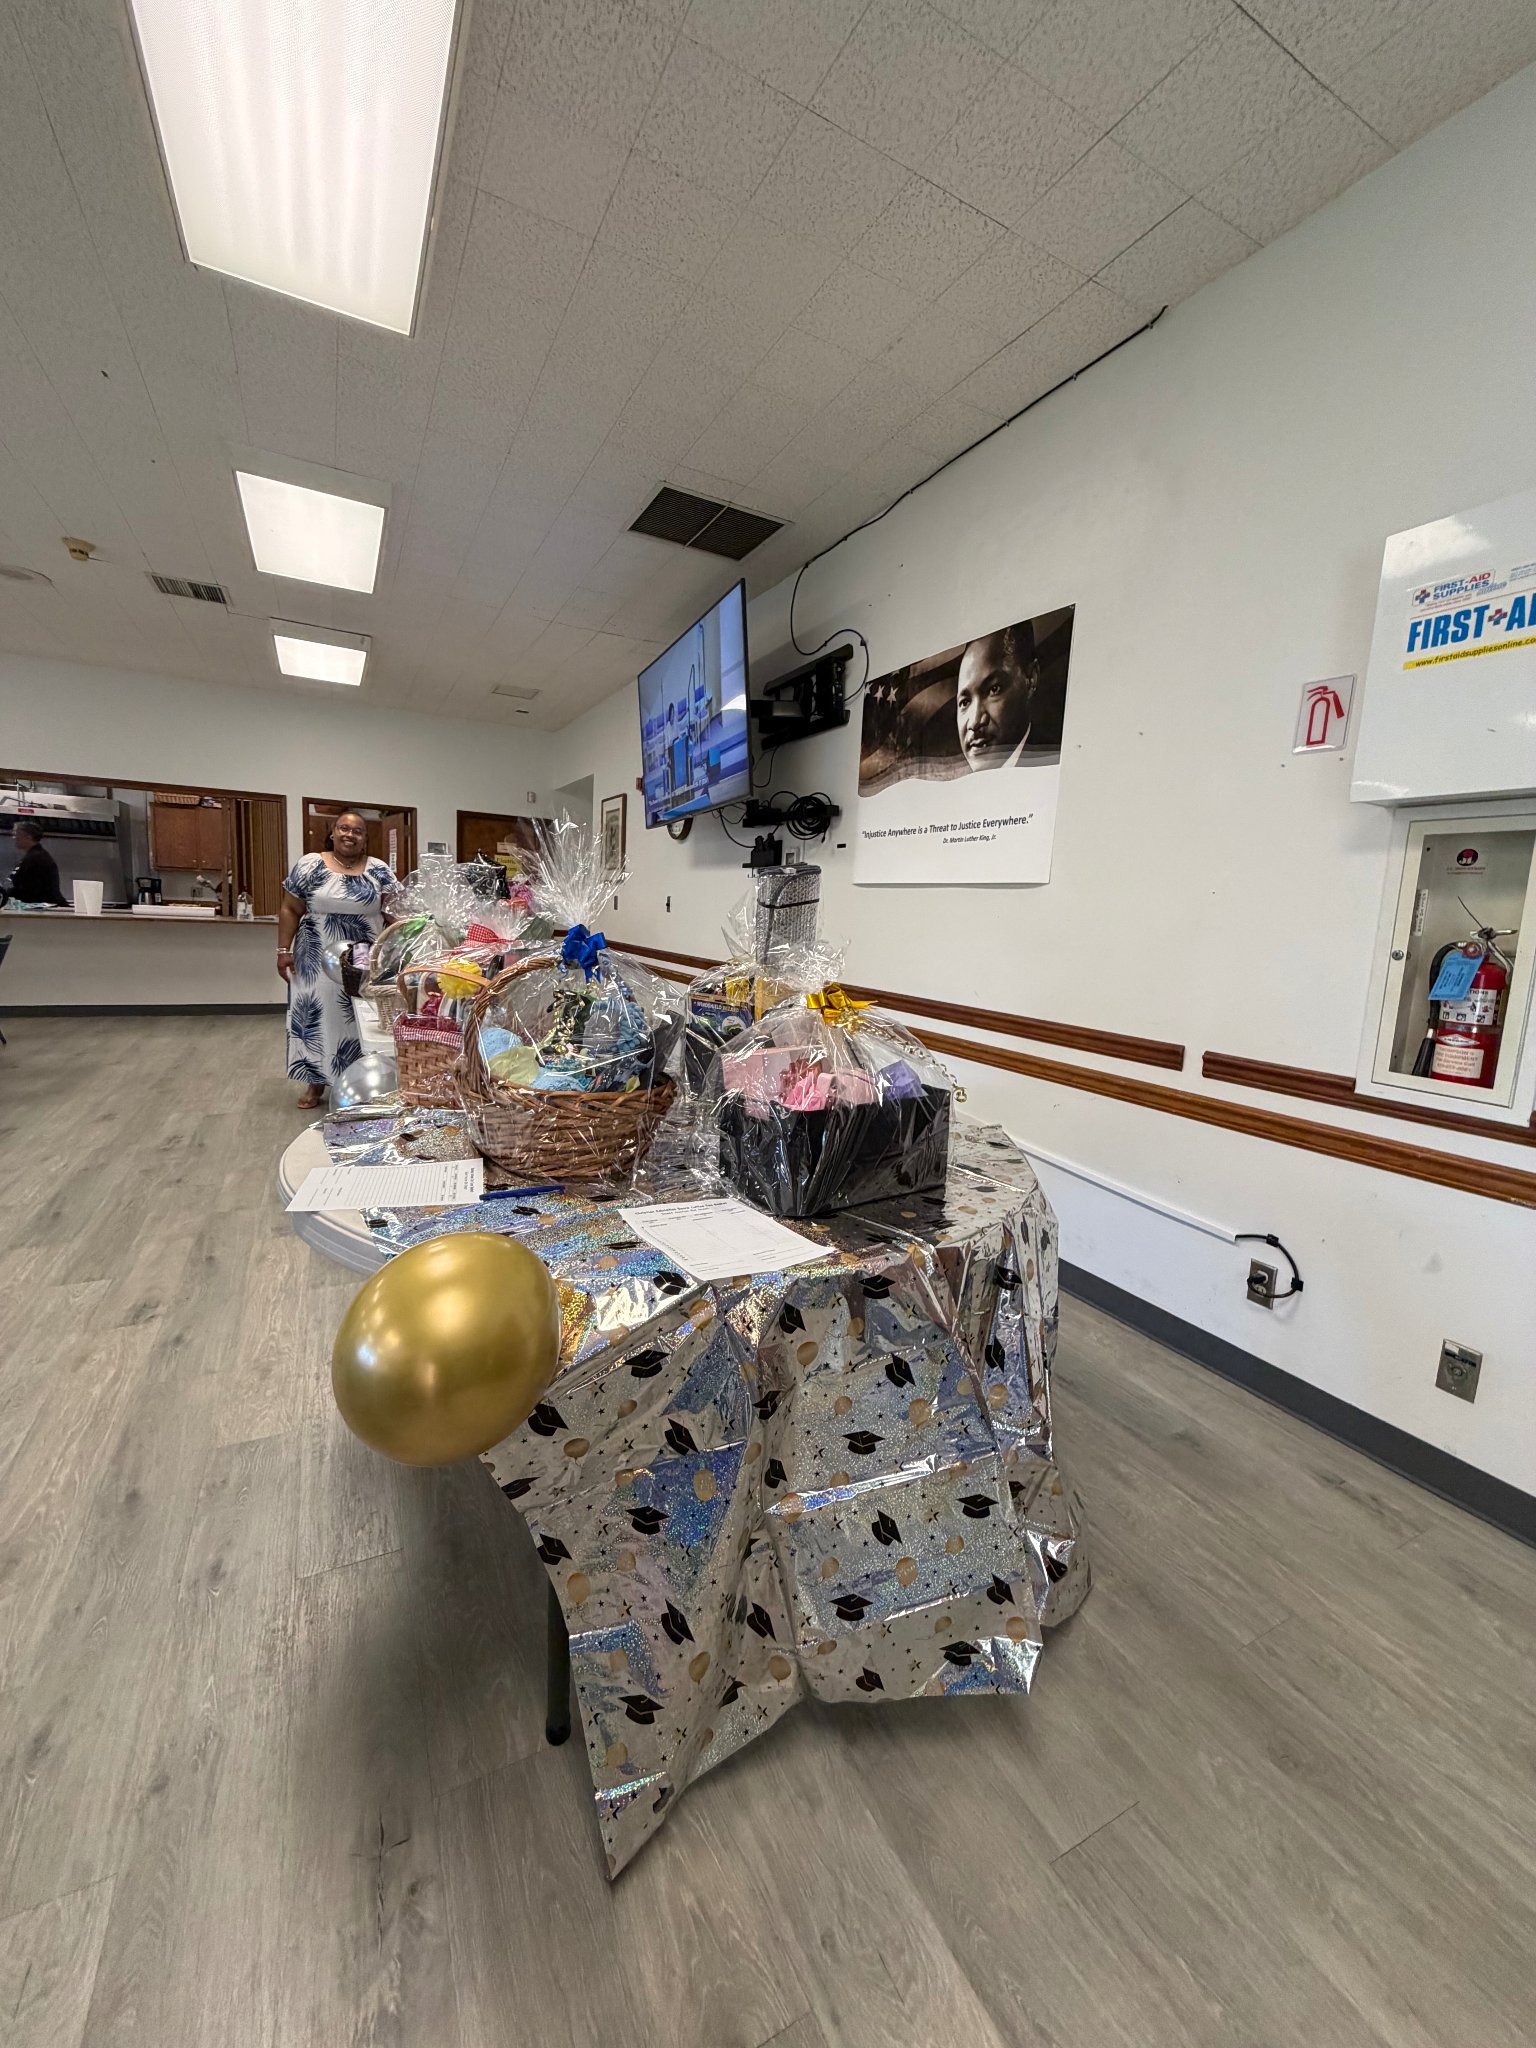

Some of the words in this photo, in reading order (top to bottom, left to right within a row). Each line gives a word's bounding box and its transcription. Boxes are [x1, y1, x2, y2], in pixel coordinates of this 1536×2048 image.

[1432, 580, 1490, 600] SUPPLIES
[1433, 572, 1491, 593] FIRST-AID
[1407, 604, 1491, 653] FIRST
[887, 827, 917, 838] Anywhere
[917, 826, 923, 835] is
[929, 824, 949, 833] Threat
[950, 823, 958, 831] to
[958, 819, 981, 831] Justice
[964, 835, 979, 843] Luther
